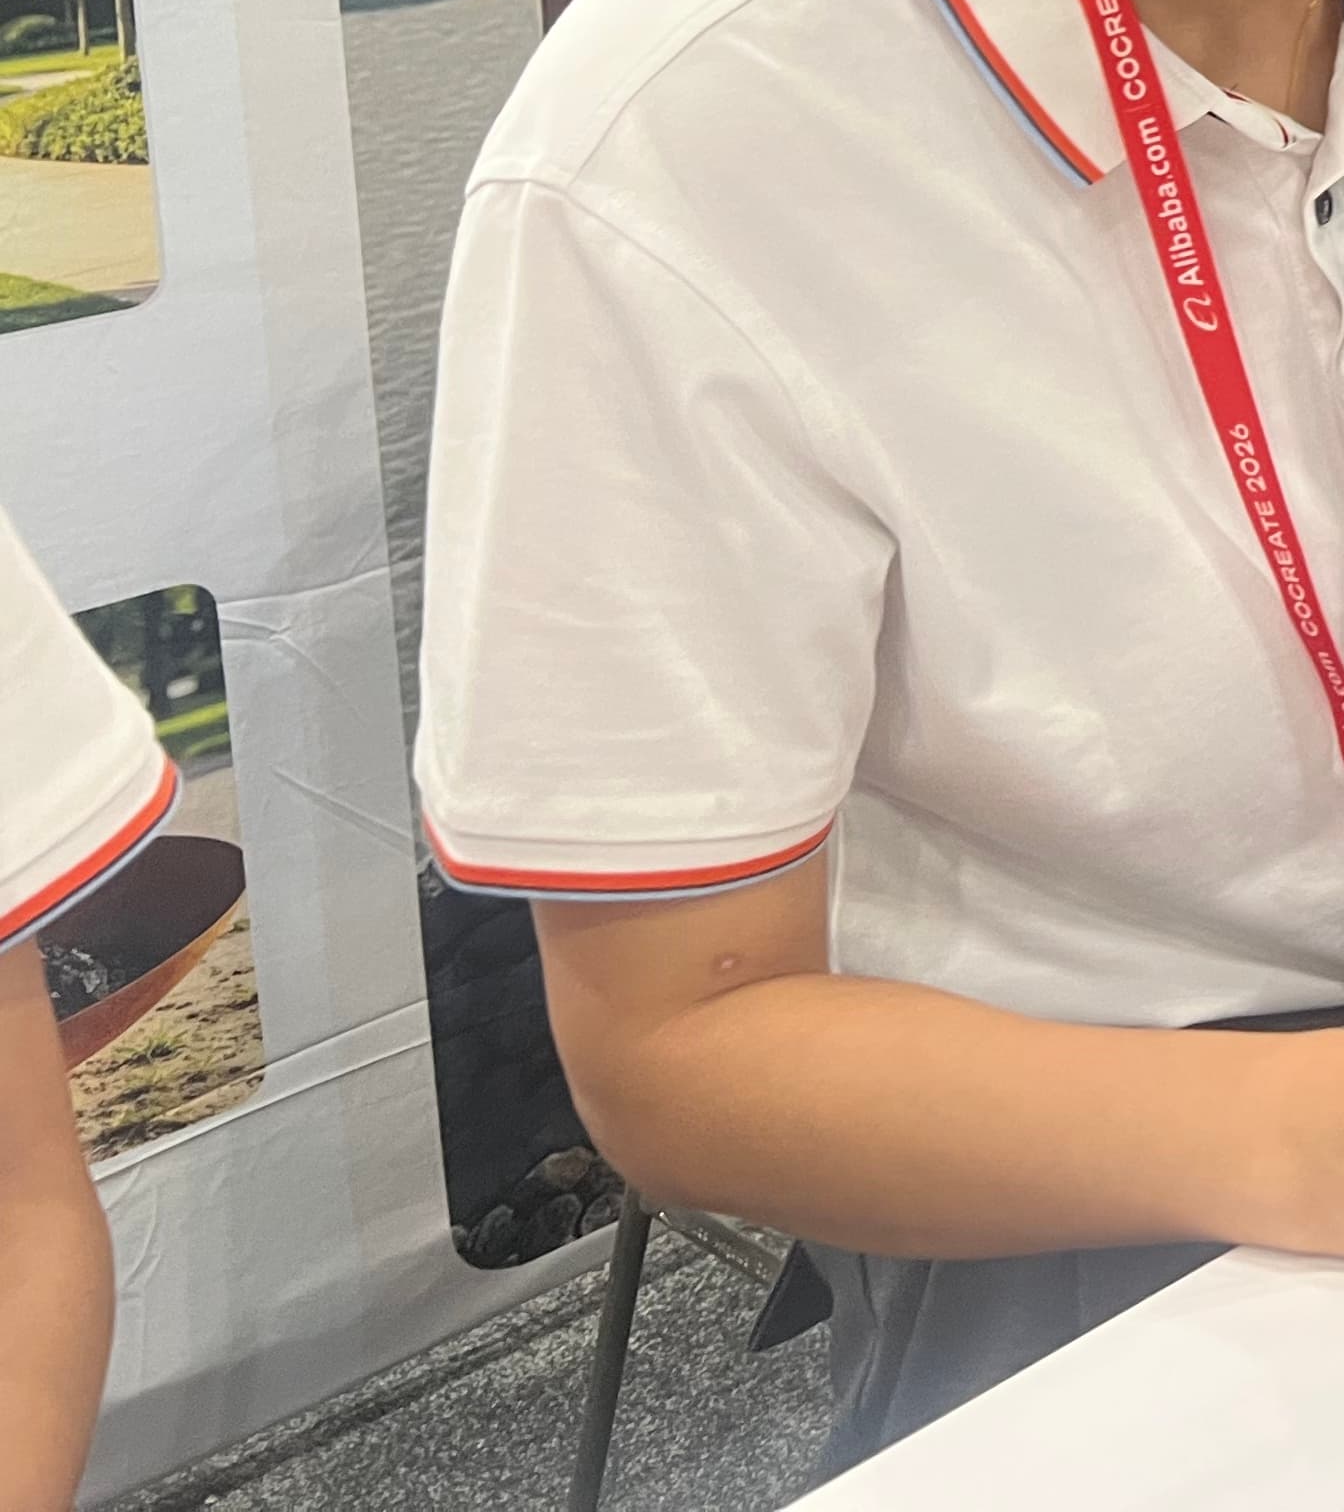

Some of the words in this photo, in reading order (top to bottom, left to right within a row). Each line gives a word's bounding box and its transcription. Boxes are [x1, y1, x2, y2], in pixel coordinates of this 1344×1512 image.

[1137, 116, 1204, 288] Alibaba.com
[1232, 422, 1266, 493] 2026
[1254, 499, 1319, 639] COCREATE
